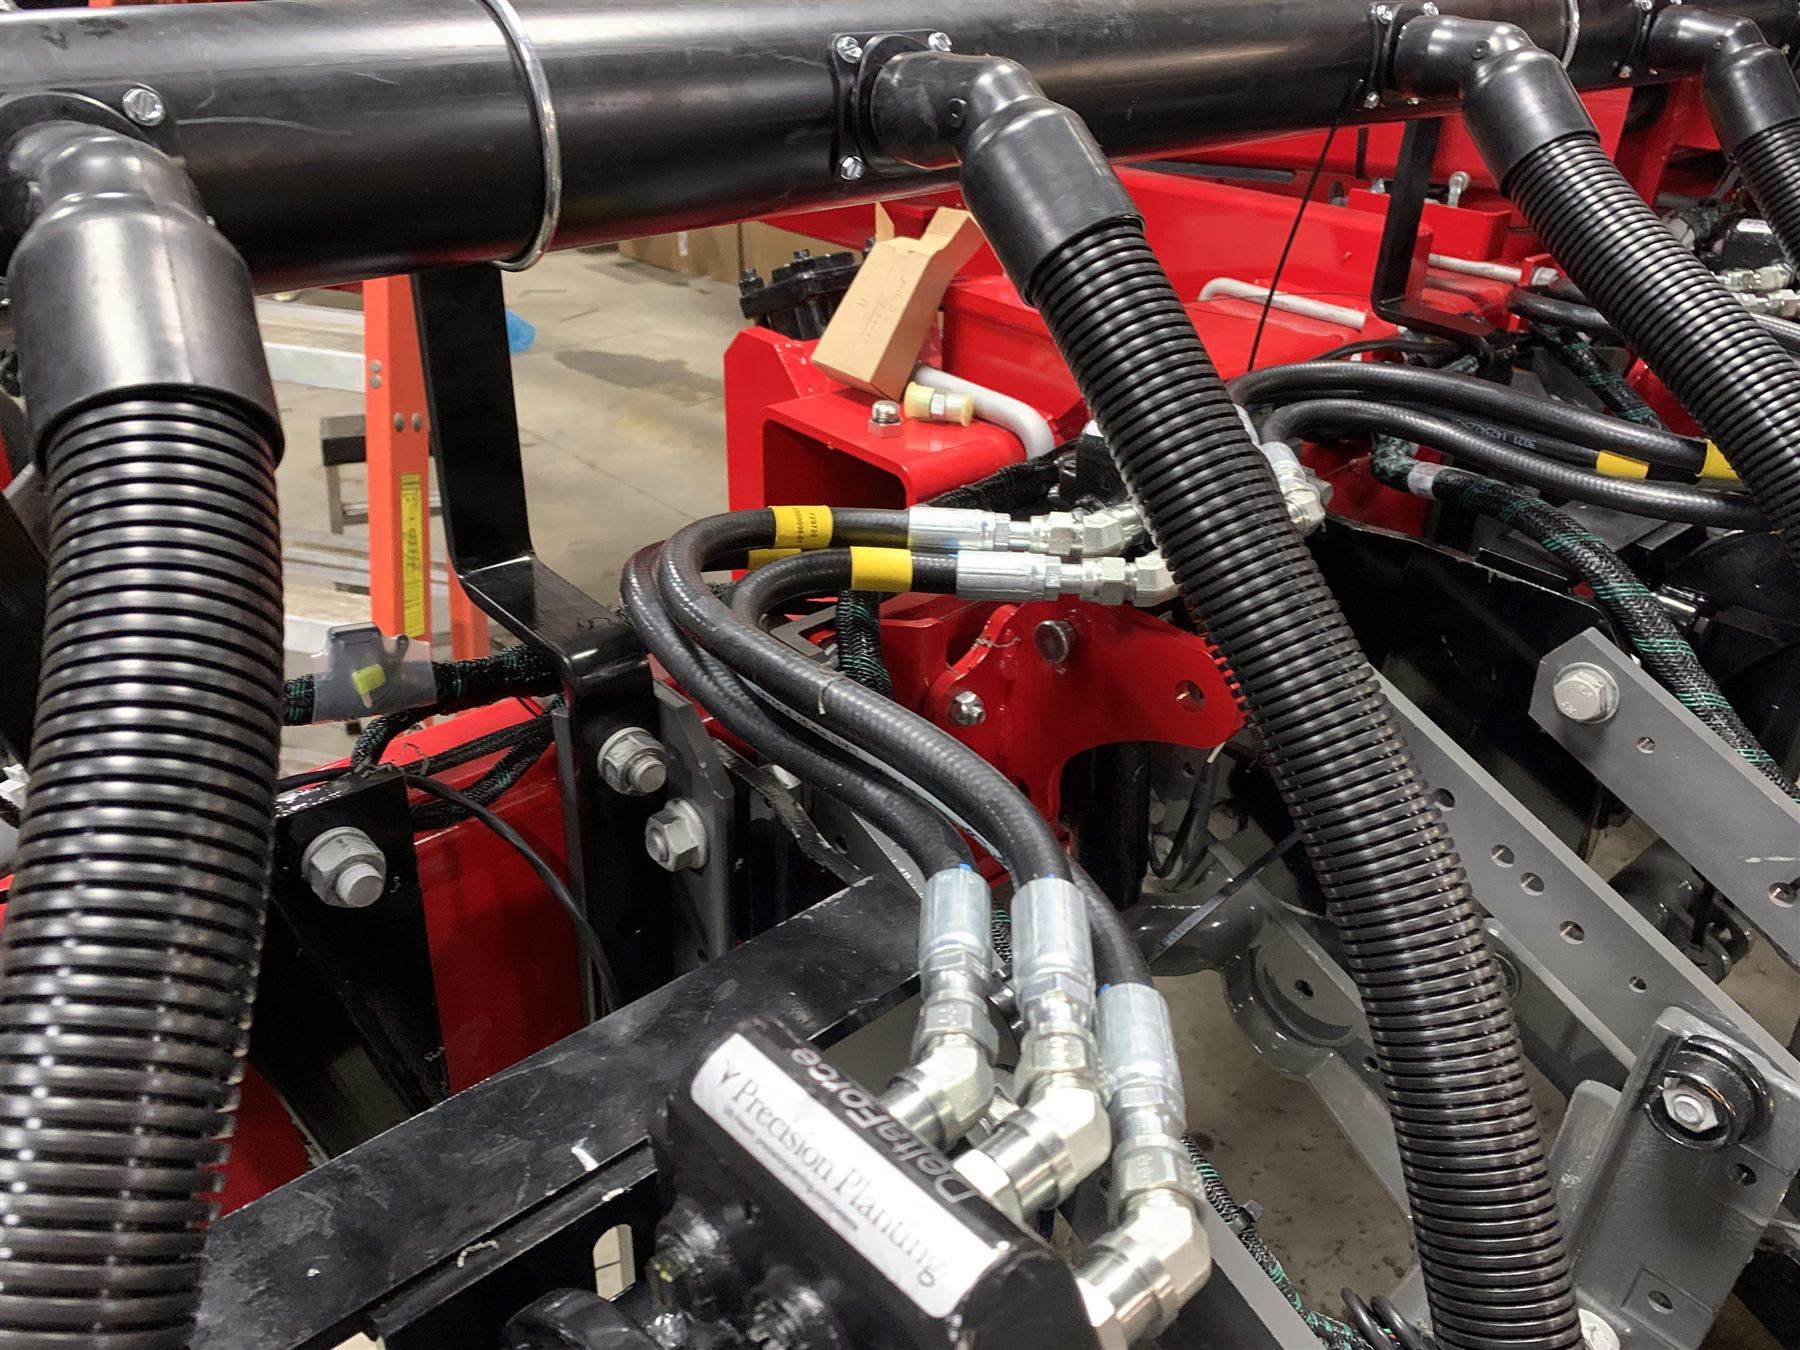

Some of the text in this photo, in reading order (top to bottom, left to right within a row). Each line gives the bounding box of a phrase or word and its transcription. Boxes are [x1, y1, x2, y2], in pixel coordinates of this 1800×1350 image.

[732, 1077, 837, 1182] Precision
[832, 1167, 947, 1289] Planting
[790, 1047, 979, 1204] DeltaForce
